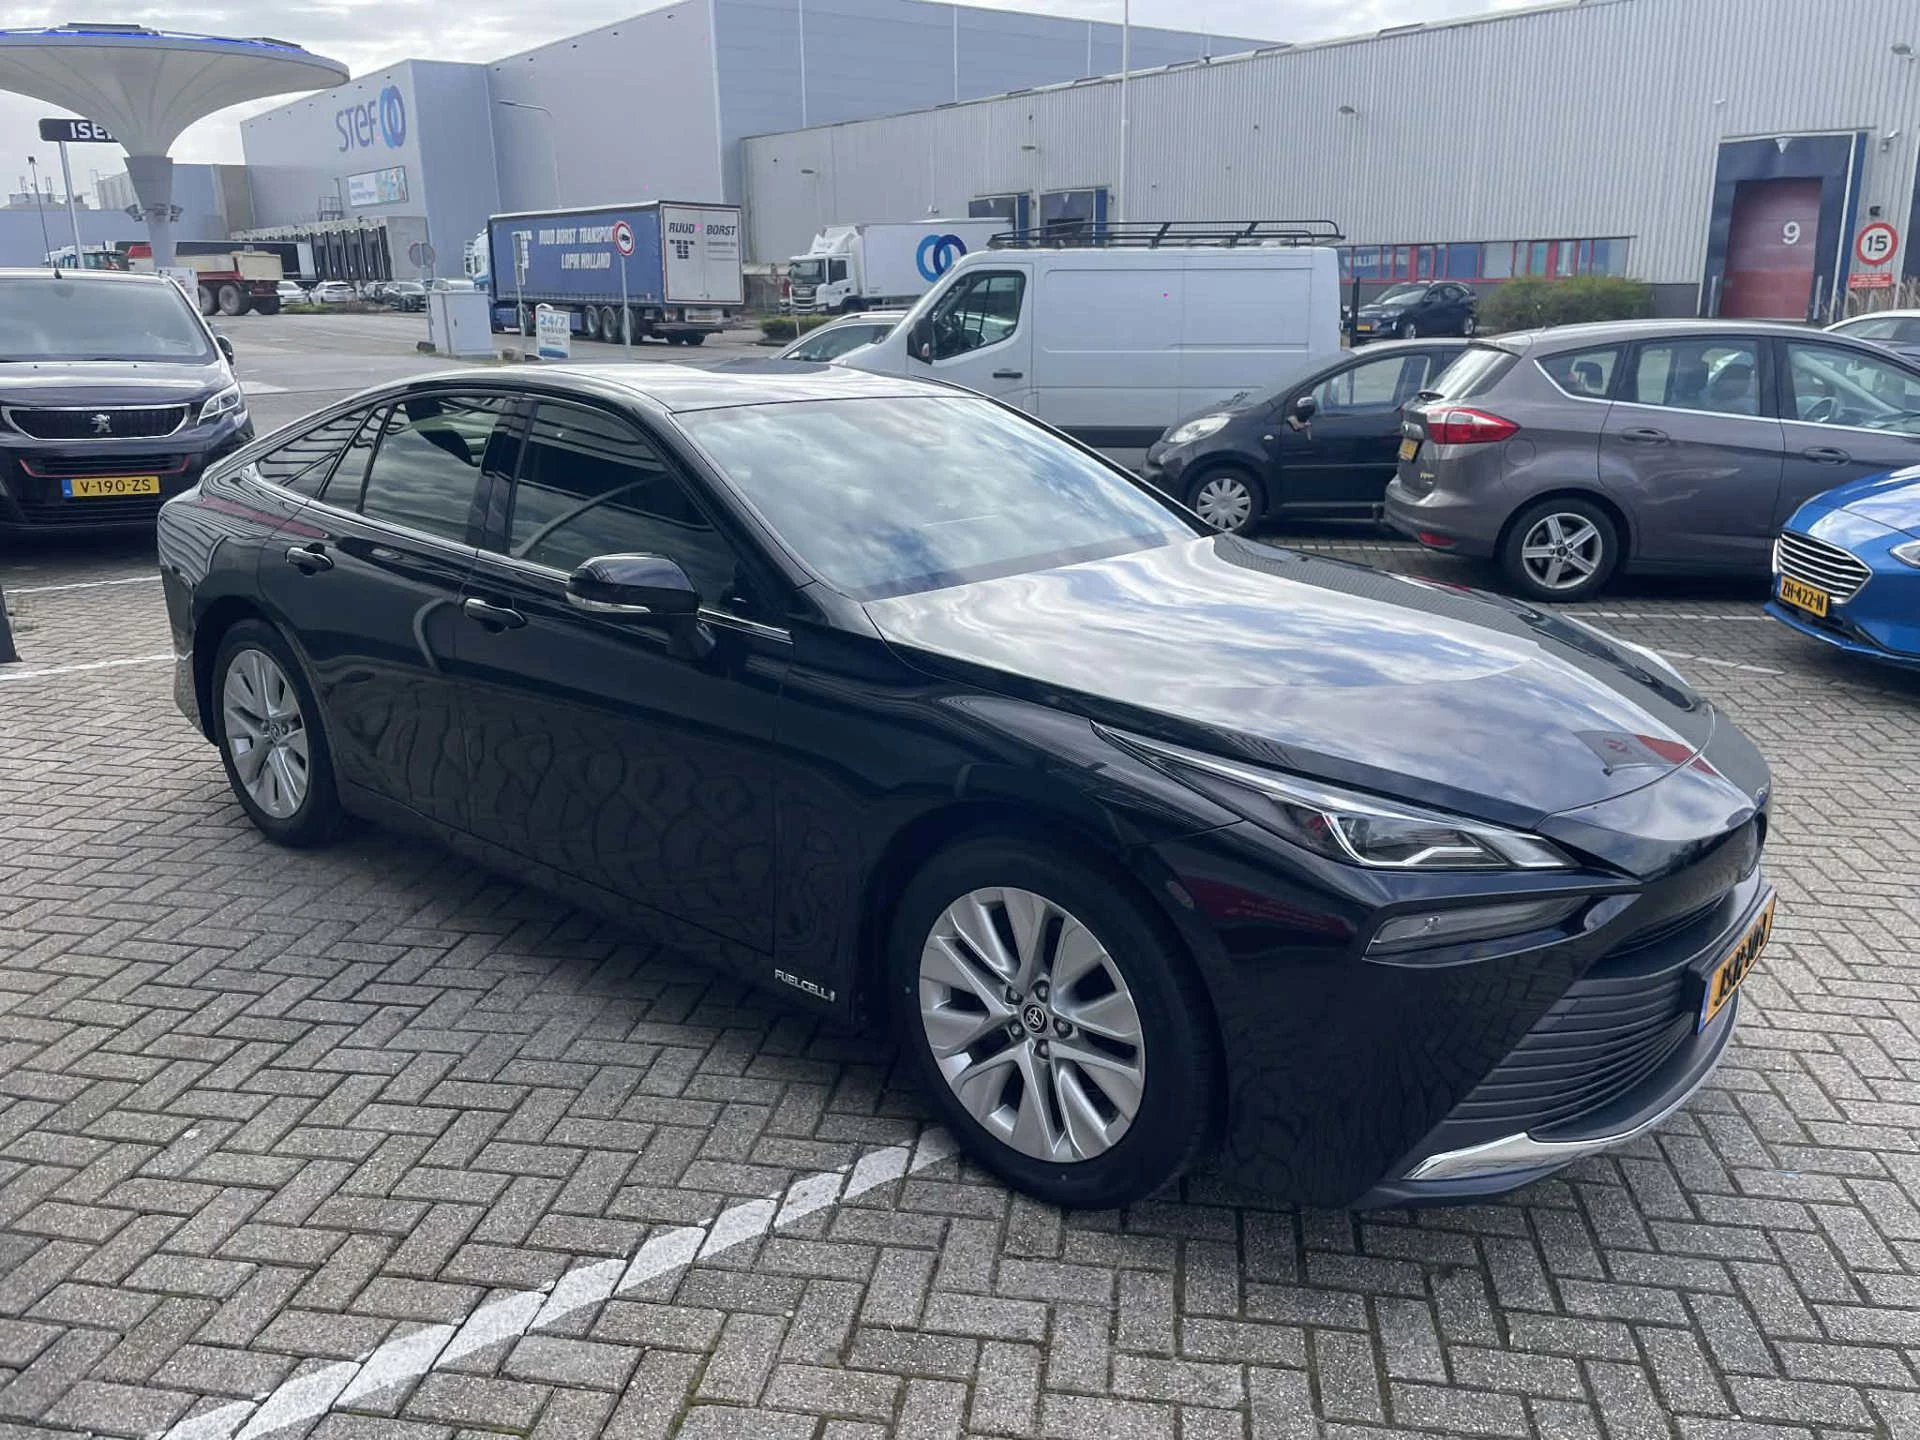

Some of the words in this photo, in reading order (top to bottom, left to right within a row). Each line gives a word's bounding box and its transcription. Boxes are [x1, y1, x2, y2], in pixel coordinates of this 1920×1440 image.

[70, 121, 112, 140] ISE
[556, 228, 577, 245] BORST
[668, 222, 696, 235] RUUD
[706, 224, 737, 237] BORST
[1783, 221, 1801, 245] 9
[1867, 234, 1888, 252] 15
[581, 252, 611, 270] HOLLAND
[539, 313, 567, 328] 24/7
[80, 479, 151, 493] V-190-ZS
